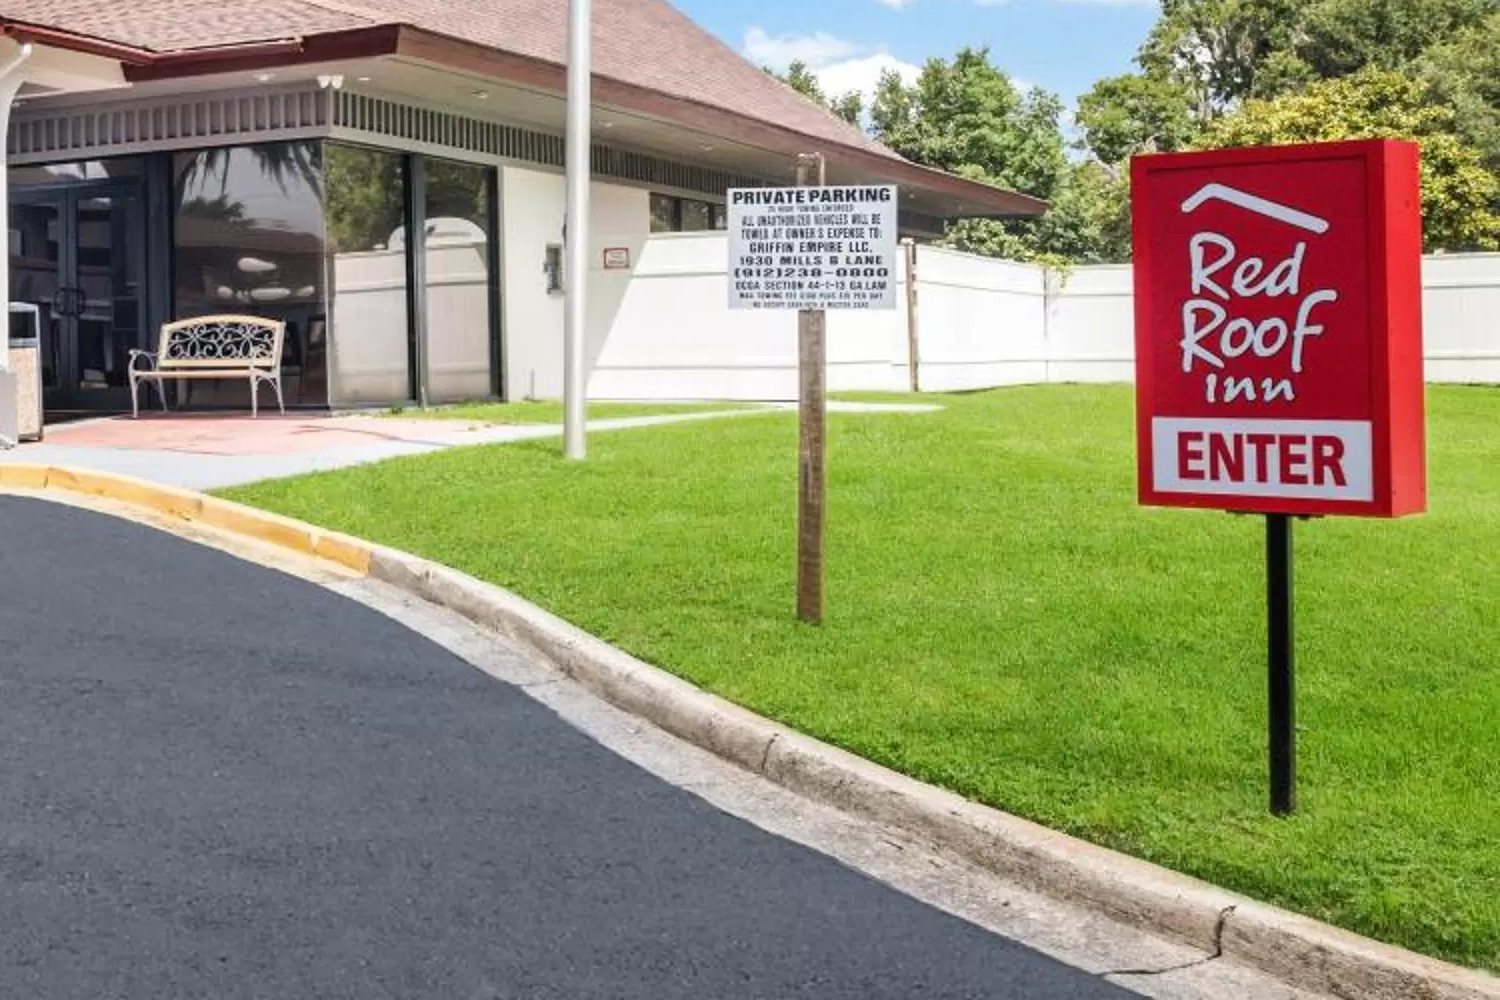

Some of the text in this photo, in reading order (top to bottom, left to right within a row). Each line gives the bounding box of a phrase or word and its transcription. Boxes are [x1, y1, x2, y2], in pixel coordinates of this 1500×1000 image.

[733, 188, 891, 204] PRIVATE PARKING
[786, 228, 824, 239] OWNERS
[827, 228, 864, 239] EXPENSE
[749, 241, 794, 253] GRIFFIN
[799, 241, 843, 253] EMPIRE
[779, 256, 822, 265] MILLS
[845, 255, 883, 265] LANE
[1189, 231, 1307, 300] Red
[1180, 289, 1337, 373] Roof
[1177, 431, 1347, 487] ENTER
